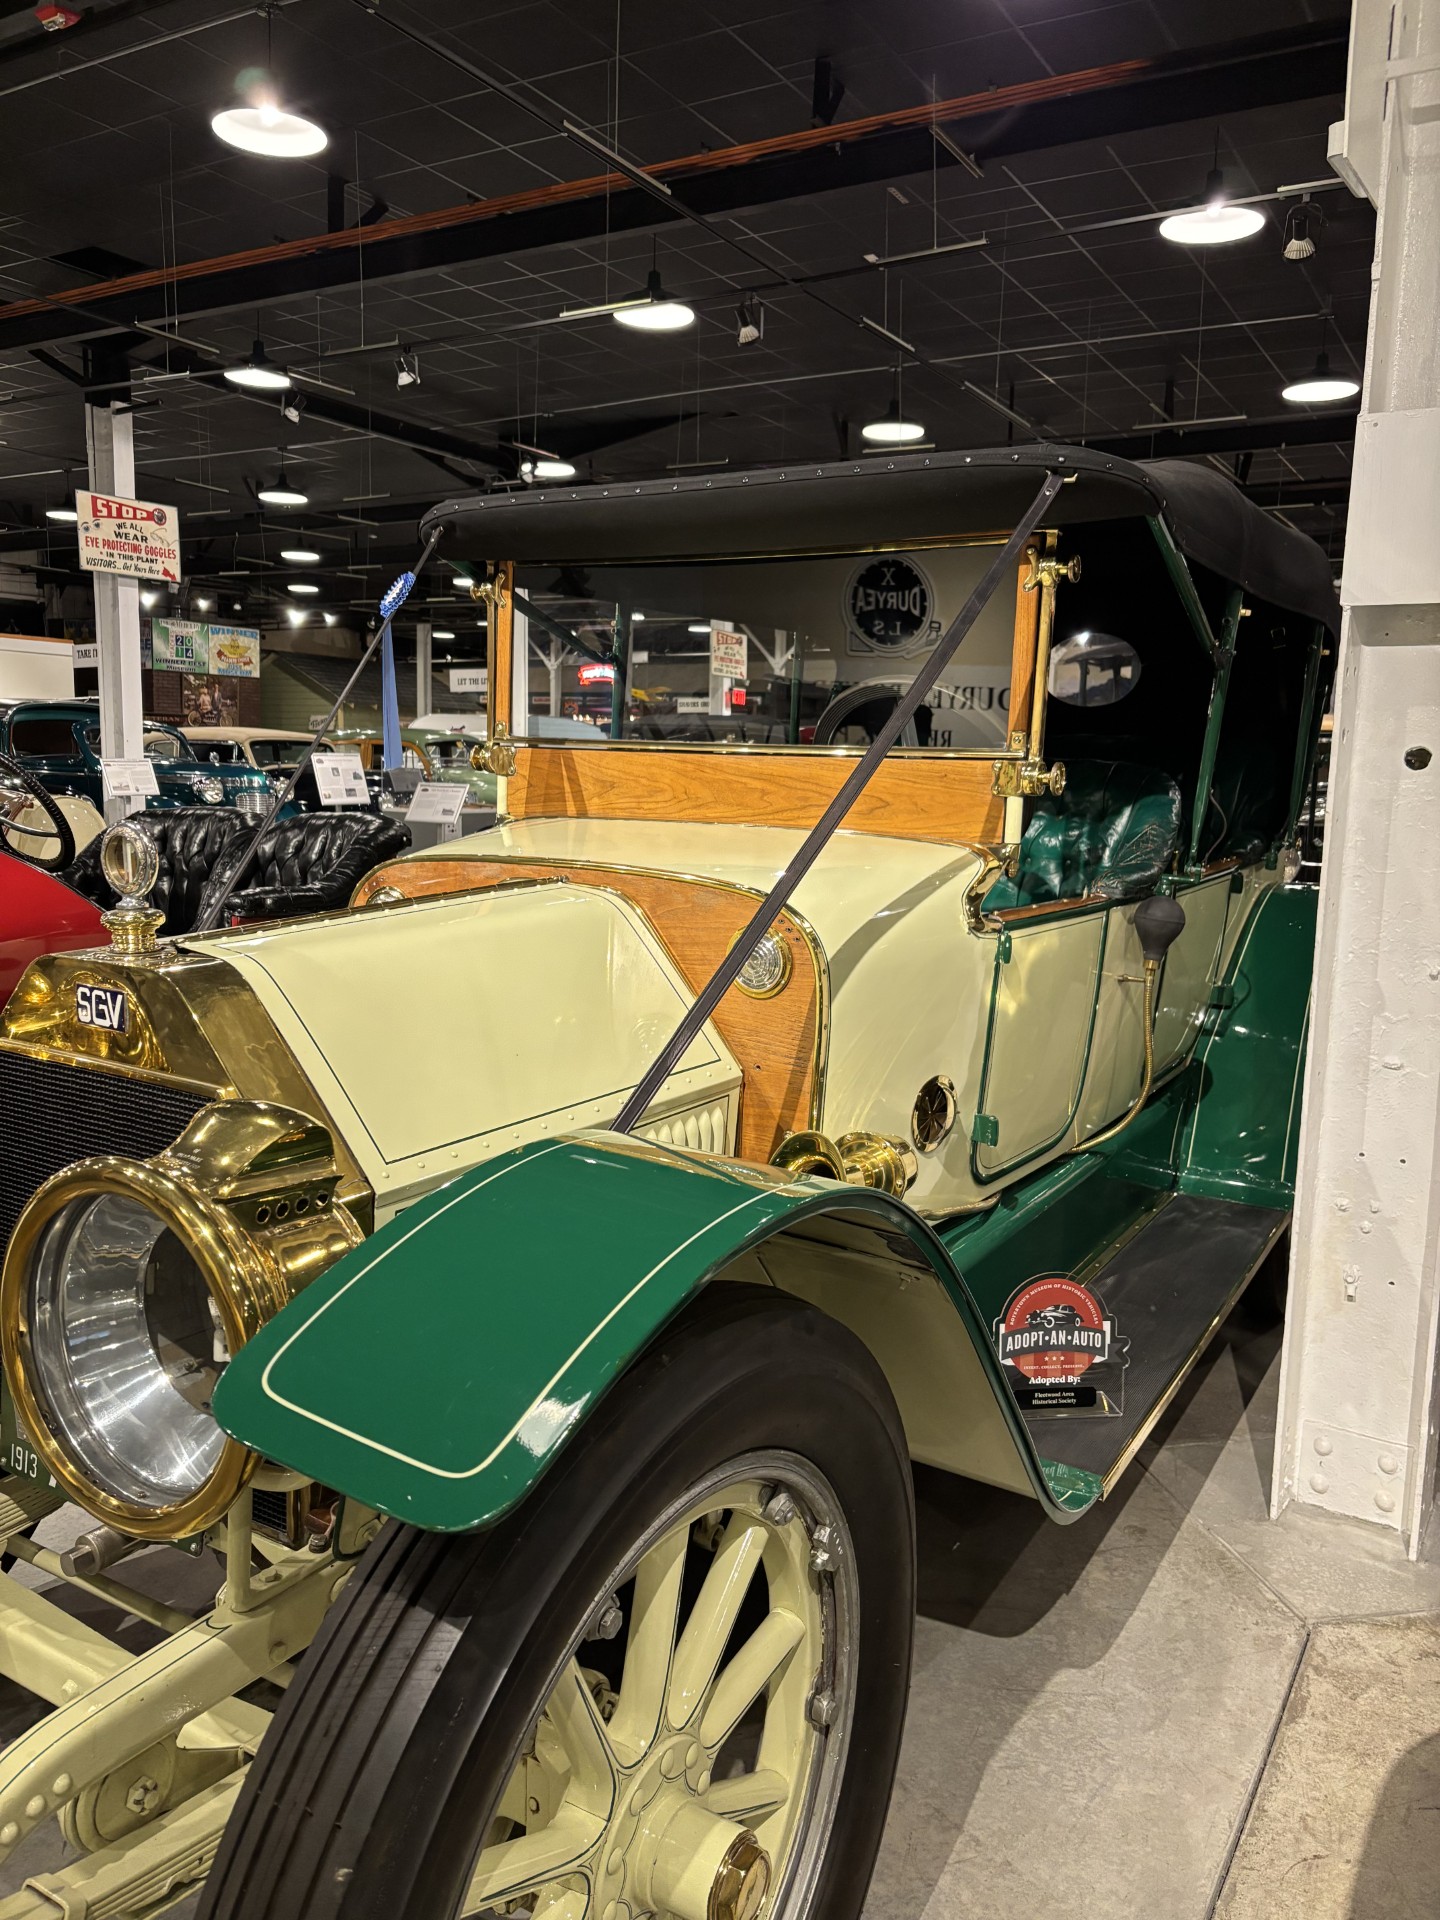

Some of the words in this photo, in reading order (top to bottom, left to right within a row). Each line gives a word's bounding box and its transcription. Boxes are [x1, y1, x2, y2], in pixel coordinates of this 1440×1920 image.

[96, 499, 148, 519] STOP
[114, 531, 148, 543] WEAR
[116, 522, 128, 531] WE
[129, 522, 144, 534] ALL
[85, 536, 99, 549] EYE
[102, 538, 142, 554] PROTECTING
[144, 544, 177, 560] GOGGLES
[106, 551, 114, 559] IN
[117, 552, 134, 561] THIS
[136, 555, 159, 565] PLANT
[77, 986, 123, 1029] SGV
[1010, 1294, 1030, 1326] BOYERTOWN
[1030, 1284, 1053, 1296] MUSEUM
[1061, 1284, 1086, 1300] HISTORIC
[1085, 1298, 1099, 1325] VEHICLES
[1029, 1375, 1066, 1386] Adopted
[1067, 1375, 1081, 1385] By:
[10, 1443, 38, 1478] 1913
